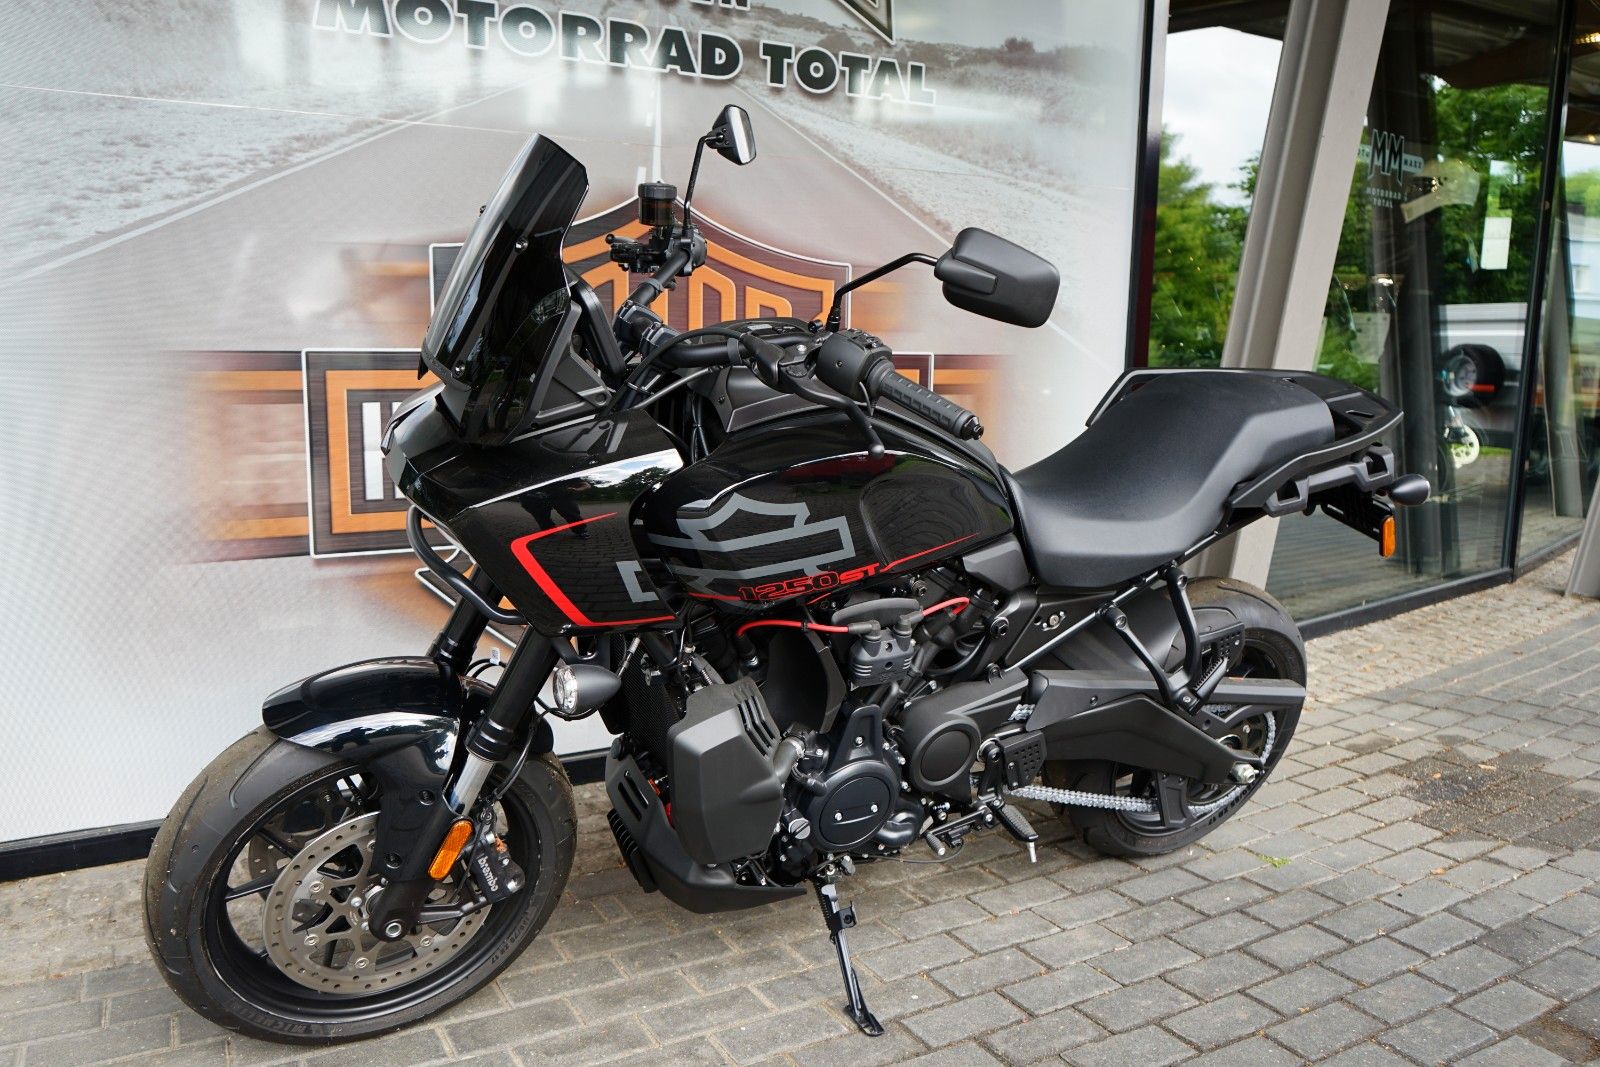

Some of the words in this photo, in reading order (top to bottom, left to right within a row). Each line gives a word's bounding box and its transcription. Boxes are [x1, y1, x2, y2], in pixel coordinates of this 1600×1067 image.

[312, 0, 743, 80] MOTORRAD
[759, 39, 936, 107] TOTAL
[477, 854, 500, 893] brembo
